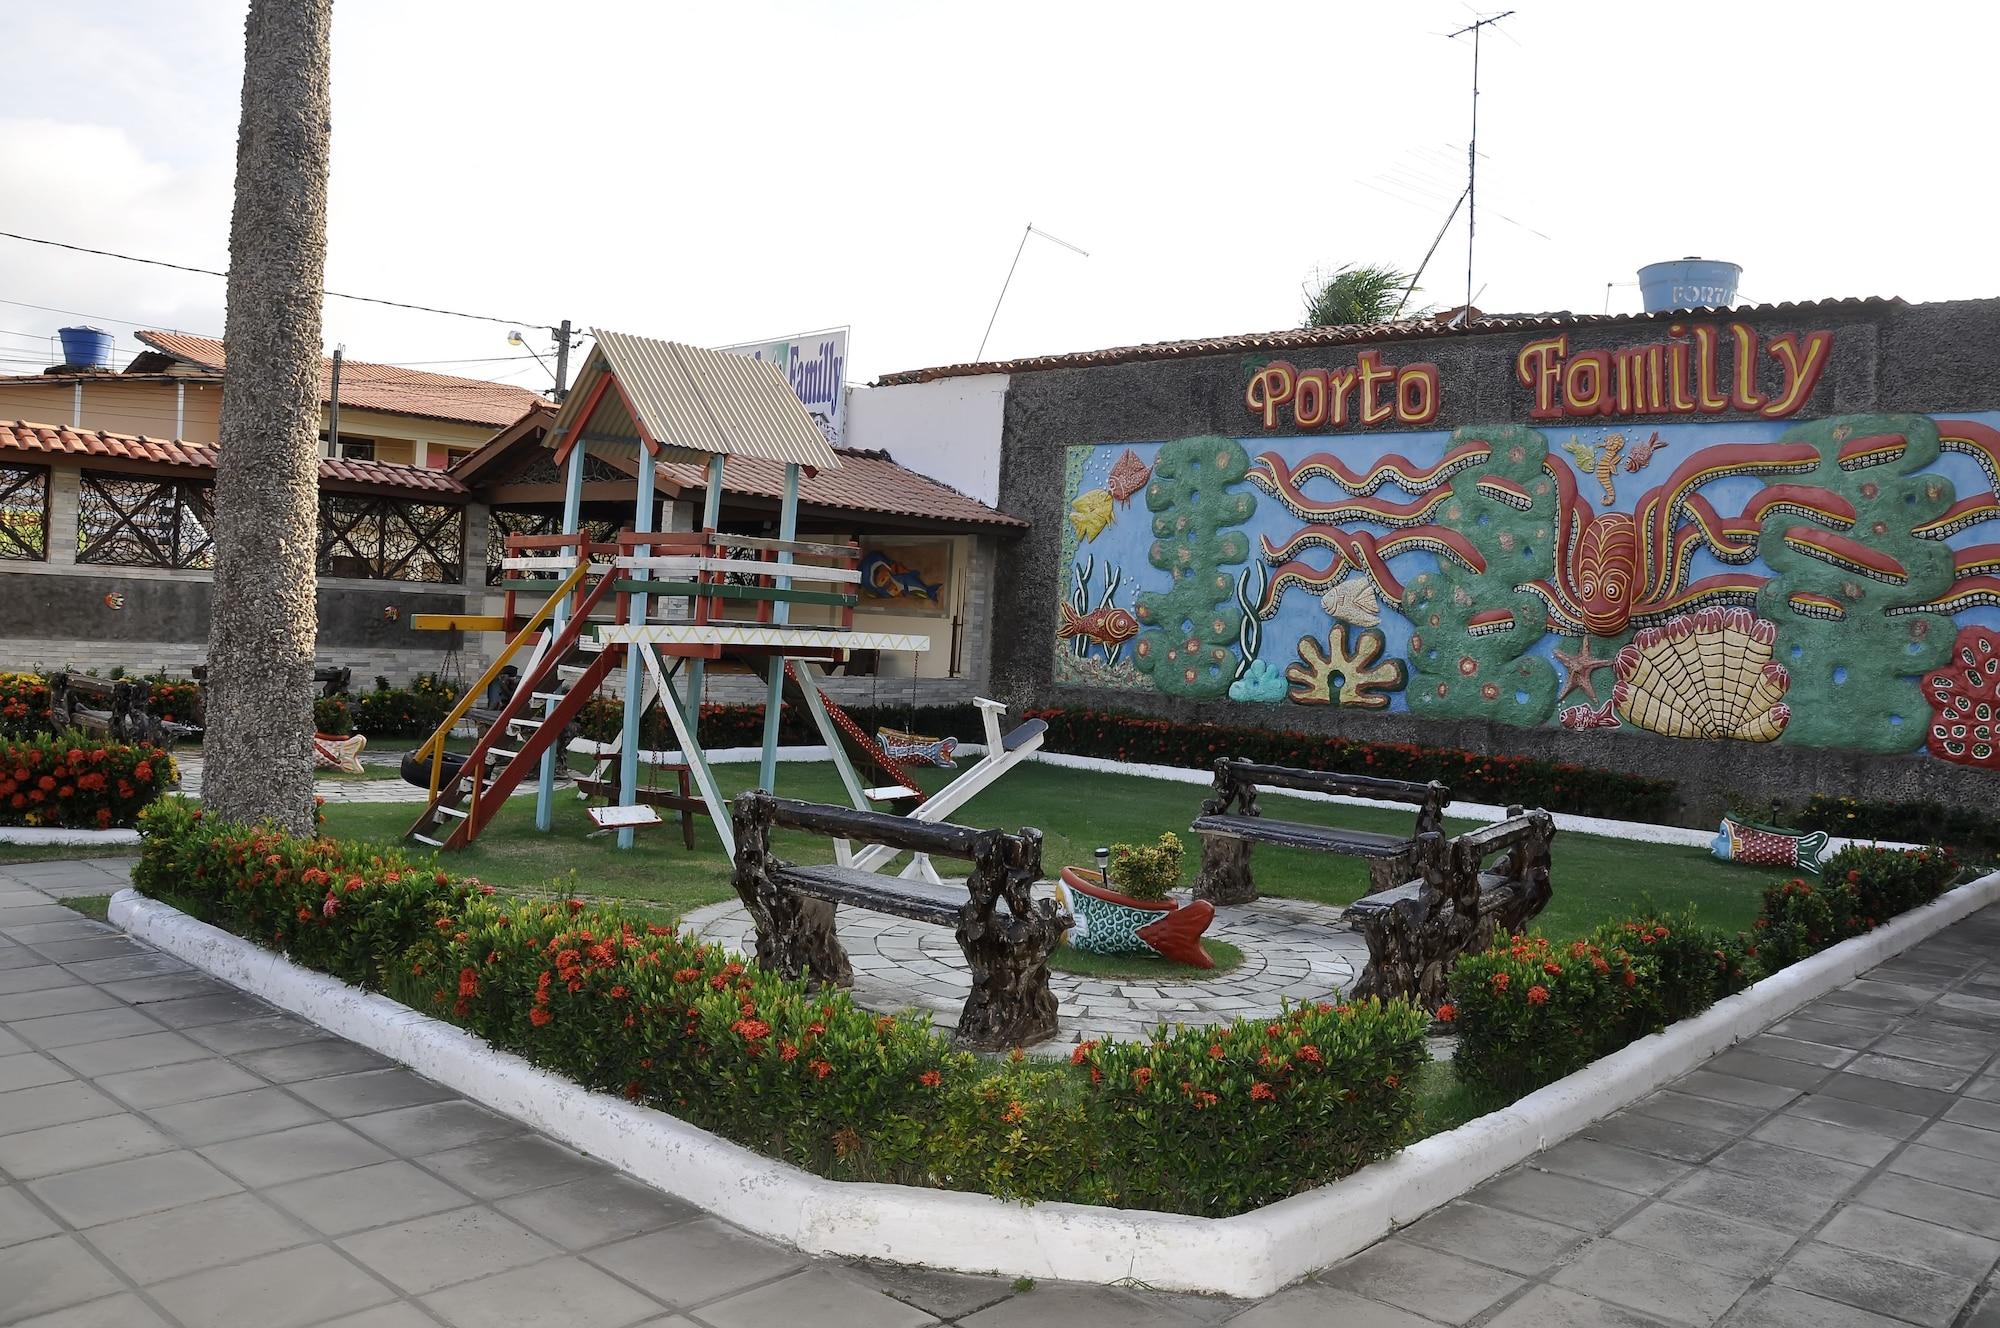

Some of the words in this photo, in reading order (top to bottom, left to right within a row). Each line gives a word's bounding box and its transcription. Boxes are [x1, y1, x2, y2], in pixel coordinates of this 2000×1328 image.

[789, 341, 842, 416] Familly
[1246, 351, 1440, 430] Porto
[1516, 323, 1834, 419] Familly
